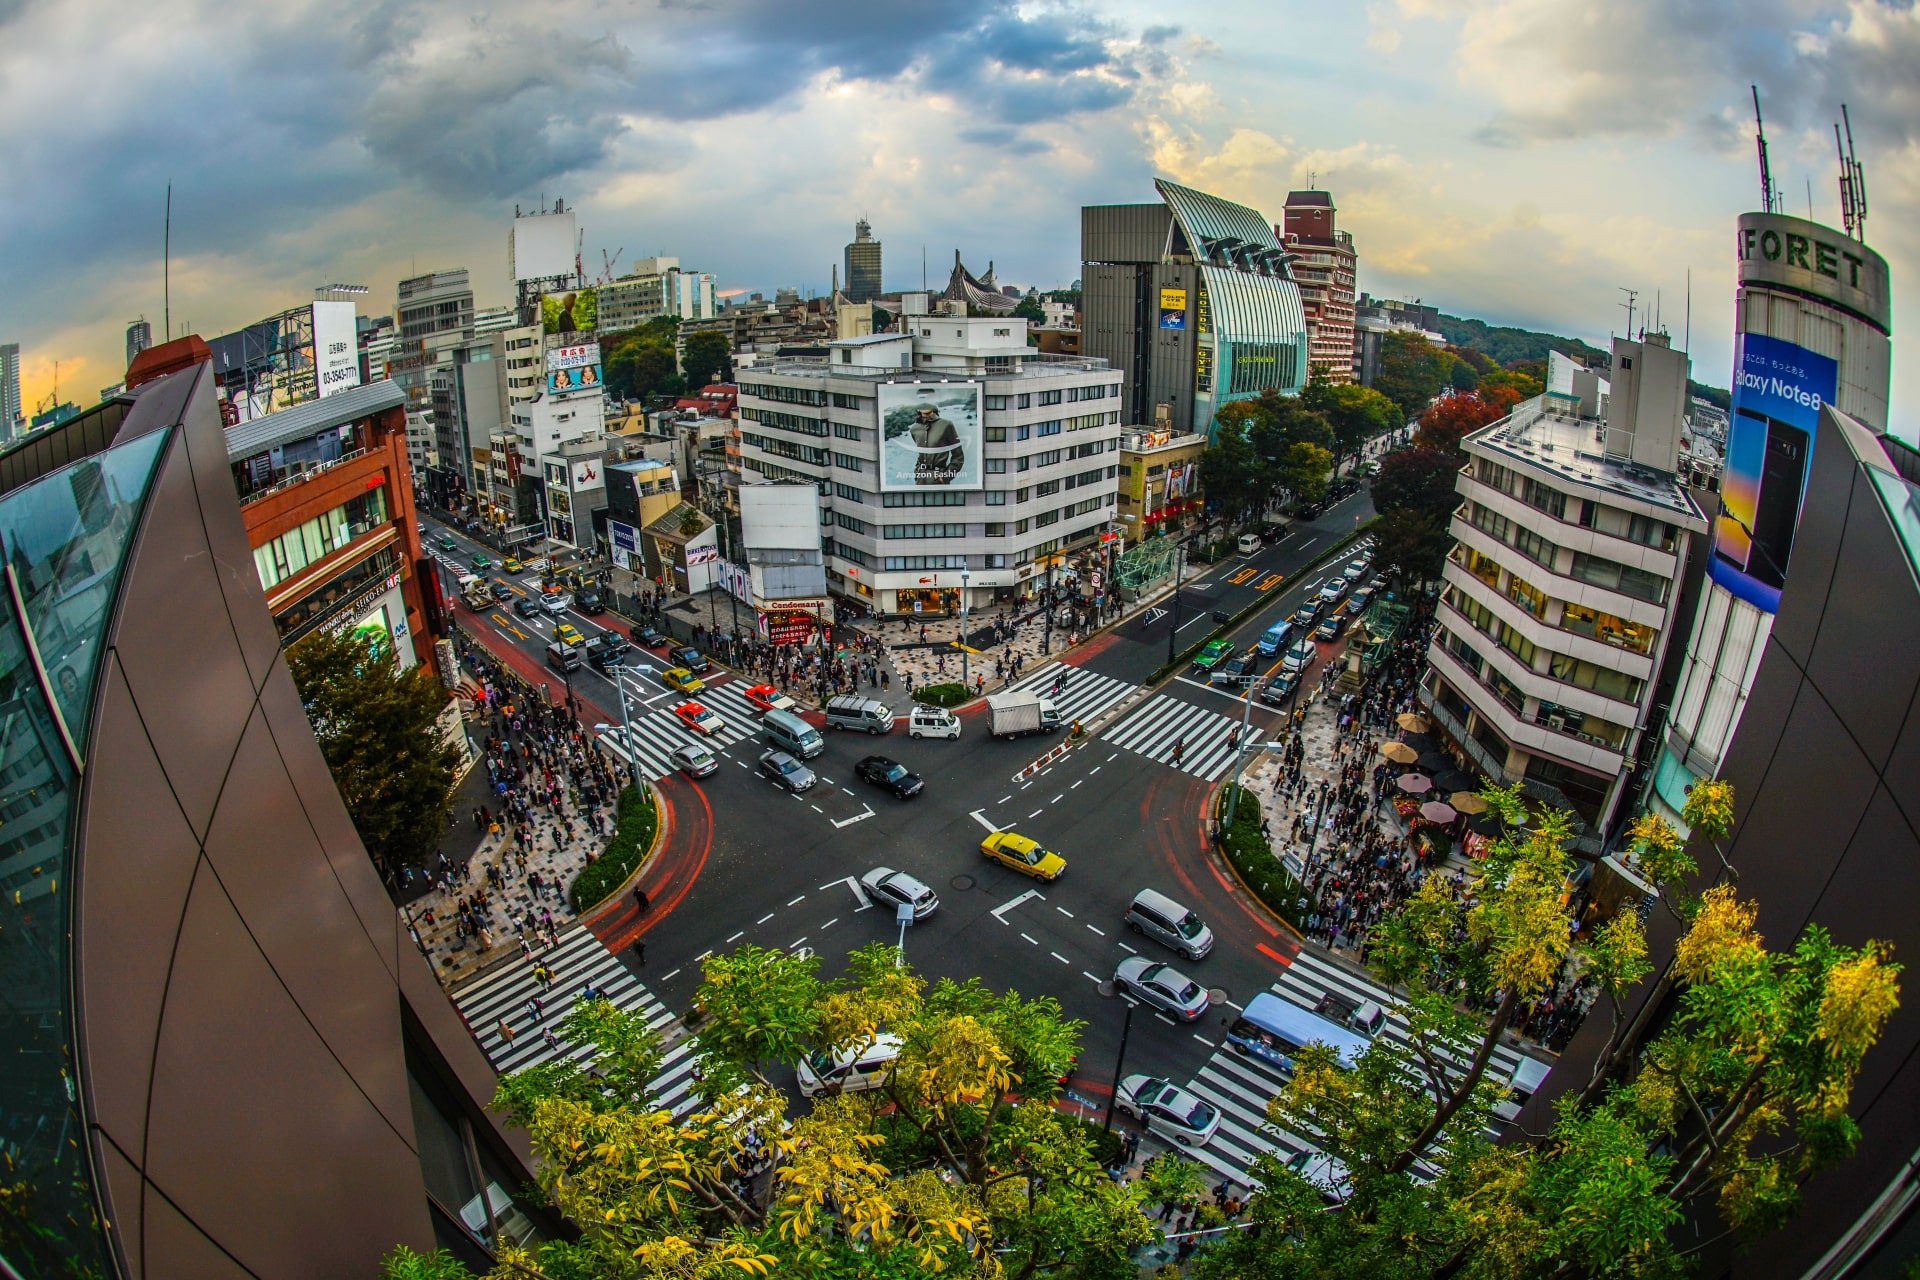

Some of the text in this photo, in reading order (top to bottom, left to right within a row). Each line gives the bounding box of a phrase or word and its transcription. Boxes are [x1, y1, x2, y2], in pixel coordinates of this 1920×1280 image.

[1735, 369, 1821, 411] Galaxy Note8
[896, 469, 968, 479] Amazon Fashion
[771, 601, 825, 609] Condomana
